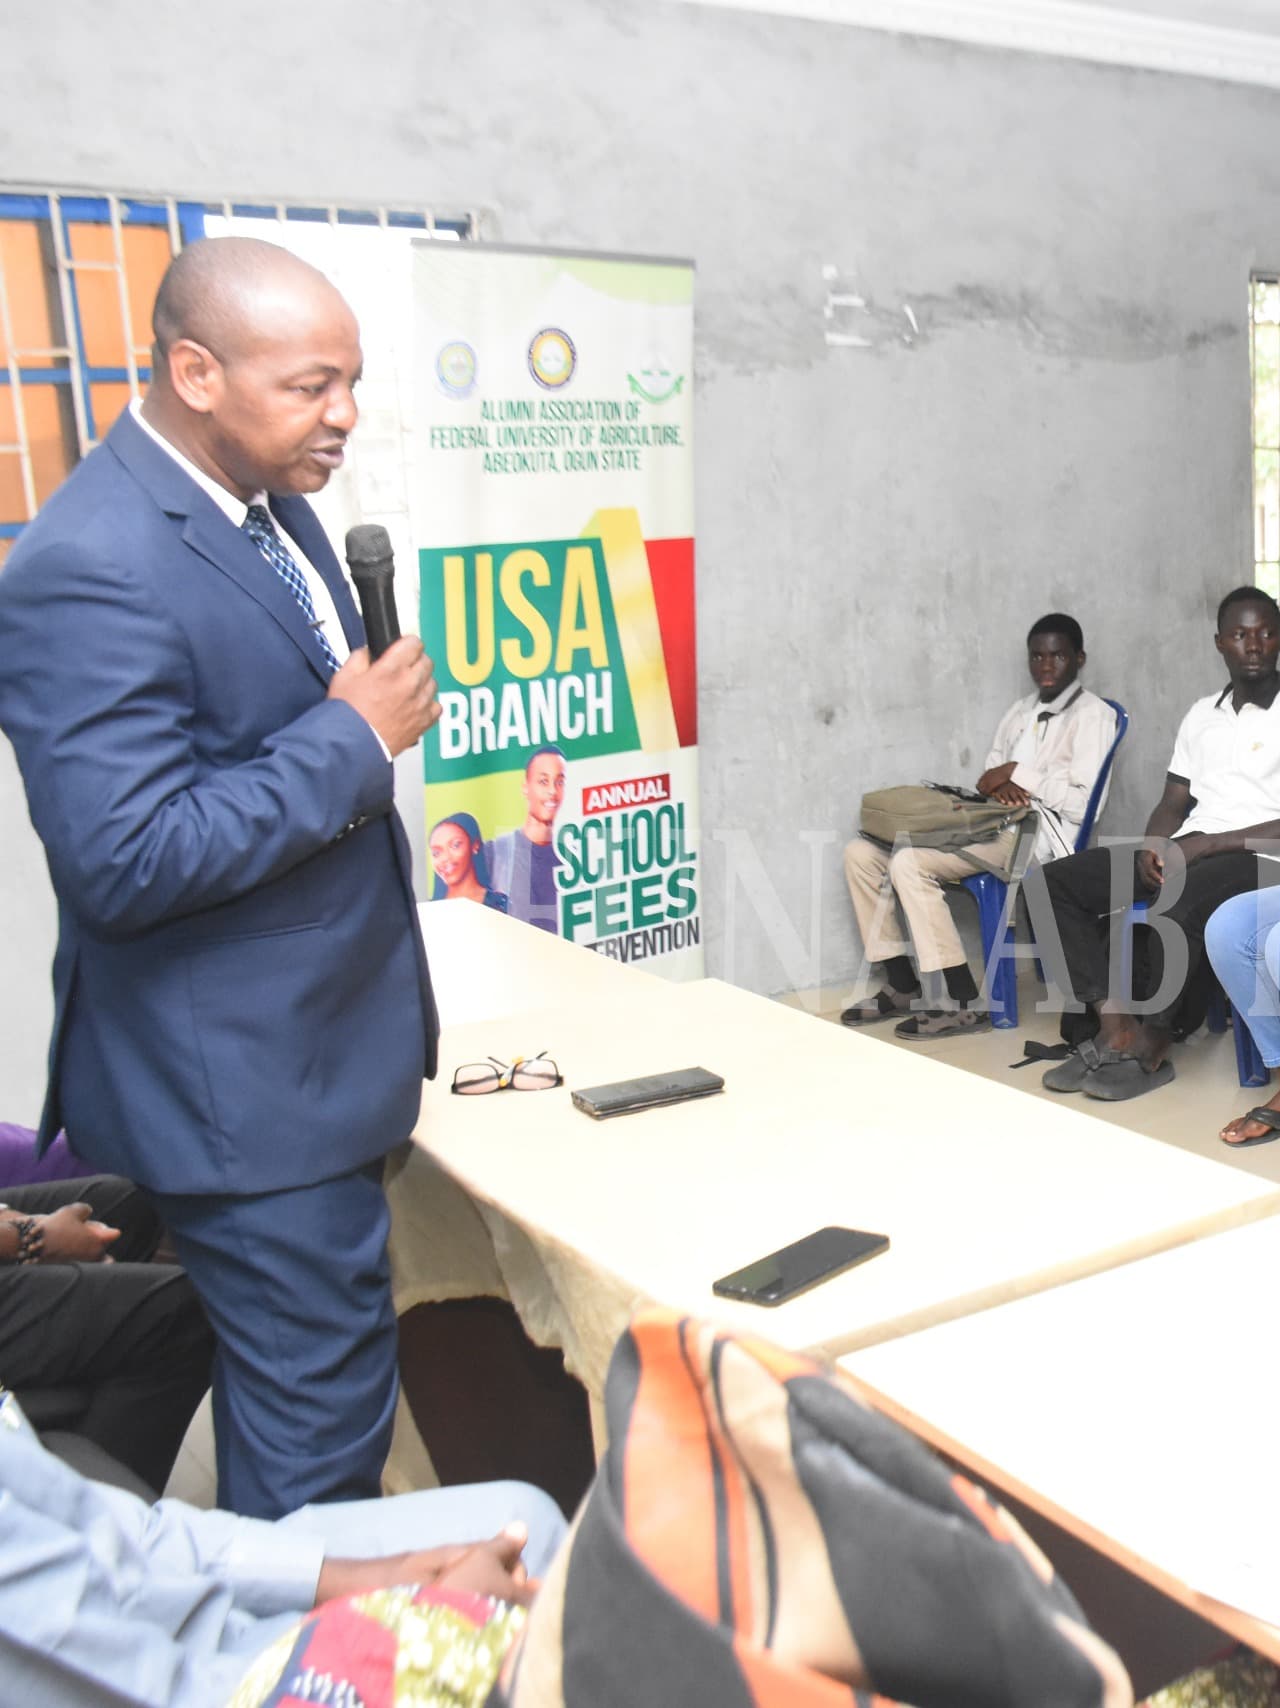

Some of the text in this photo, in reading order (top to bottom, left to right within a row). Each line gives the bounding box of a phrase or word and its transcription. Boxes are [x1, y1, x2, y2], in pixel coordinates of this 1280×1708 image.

[430, 425, 490, 449] FEDERAL
[496, 425, 576, 448] UNIVERSITY
[579, 424, 594, 447] OF
[481, 399, 641, 421] ALUMNI ASSOCIATION OF
[564, 450, 599, 473] OGUN
[601, 449, 642, 471] STATE
[443, 546, 609, 686] USA
[438, 671, 614, 759] BRANCH
[586, 778, 668, 812] ANNUAL
[557, 802, 697, 889] SCHOOL
[562, 867, 697, 943] FEES
